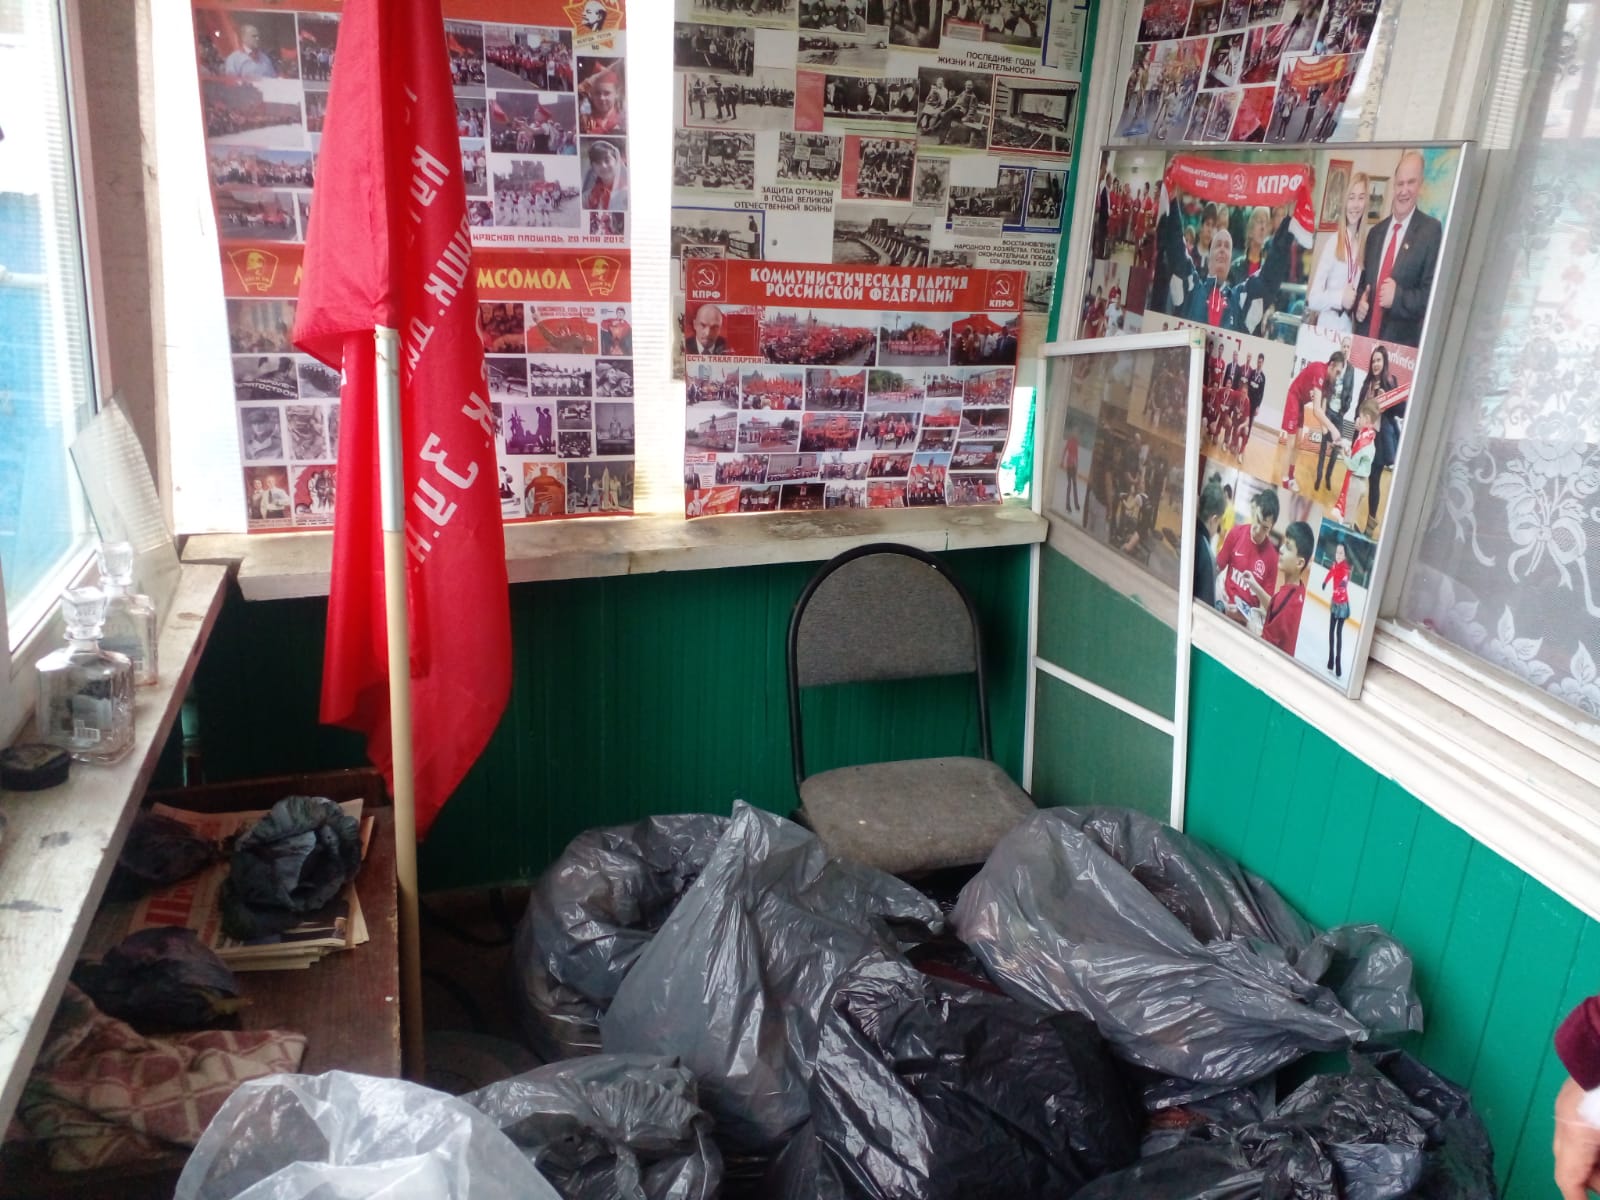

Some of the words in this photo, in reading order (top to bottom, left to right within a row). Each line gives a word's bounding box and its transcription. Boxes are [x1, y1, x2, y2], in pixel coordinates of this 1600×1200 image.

[966, 51, 1012, 64] ПОСЛЕДНИЕ
[1015, 58, 1036, 67] ГОДЫ
[938, 56, 967, 67] ЖИЗНИ
[969, 60, 975, 68] И
[977, 61, 1036, 75] ДЕЯТЕЛЬНОСТИ
[1256, 174, 1303, 195] КПРФ
[762, 186, 794, 195] ЗАЩИТА
[795, 188, 834, 196] ОТЧИЗНЫ
[771, 195, 794, 204] ГОДЫ
[797, 196, 833, 204] ВЕЛИКОЙ
[734, 201, 800, 211] ОТЕЧЕСТВЕННОЙ
[803, 204, 833, 213] ВОЙНЫ
[473, 233, 515, 242] КРАСНАЯ
[604, 236, 625, 244] 2012
[954, 243, 991, 251] НАРОДНОГО
[476, 267, 572, 290] МСОМОЛ
[750, 267, 911, 289] КОММУНИСТИЧЕСКАЯ
[917, 275, 968, 290] ПАРТИЯ
[692, 289, 721, 299] КПРФ
[766, 281, 863, 301] РОССИЙСКОЙ
[869, 287, 953, 304] ФЕДЕРАЦИИ
[989, 299, 1015, 308] КПРФ
